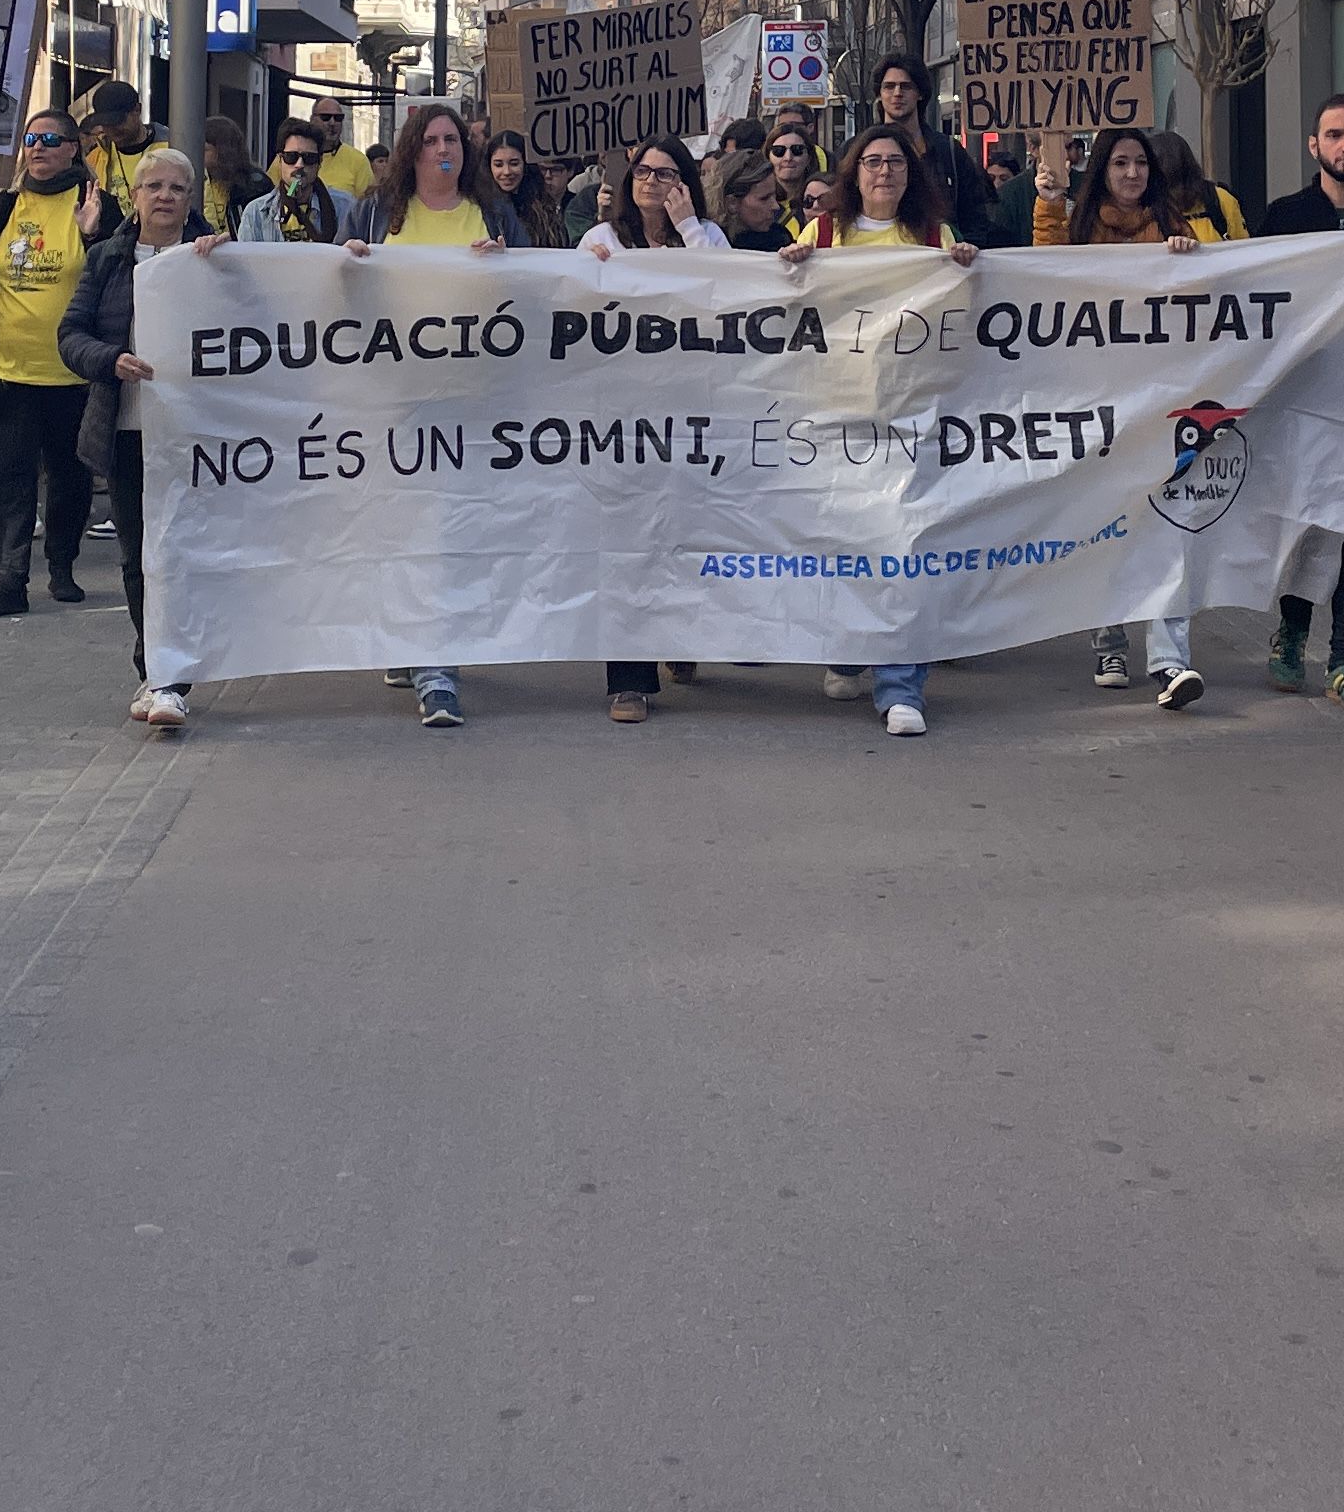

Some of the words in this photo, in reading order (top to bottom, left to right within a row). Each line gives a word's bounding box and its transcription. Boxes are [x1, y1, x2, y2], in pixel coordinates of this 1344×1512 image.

[487, 9, 508, 25] LA
[988, 1, 1074, 38] PENSA
[530, 19, 583, 63] FER
[963, 42, 1008, 76] ENS
[1017, 40, 1081, 74] ESTEU
[1088, 36, 1147, 74] FENT
[536, 68, 567, 97] NO
[573, 52, 639, 91] SURT
[647, 49, 678, 81] AL
[191, 300, 524, 377] EDUCACIÓ
[551, 301, 827, 360] PÚBLICA
[848, 308, 866, 355] I
[894, 307, 968, 355] DE
[976, 291, 1292, 360] QUALITAT
[191, 435, 275, 488] NO
[297, 412, 366, 482] ÉS
[387, 424, 464, 476] UN
[489, 415, 726, 477] SOMNI,
[751, 400, 818, 470] ÉS
[843, 404, 920, 466] UN
[938, 405, 1116, 468] DRET!
[1205, 455, 1240, 480] DUC
[1163, 485, 1179, 500] de
[700, 554, 873, 579] ASSEMBLEA
[881, 552, 942, 579] DUC
[945, 549, 981, 572] DE
